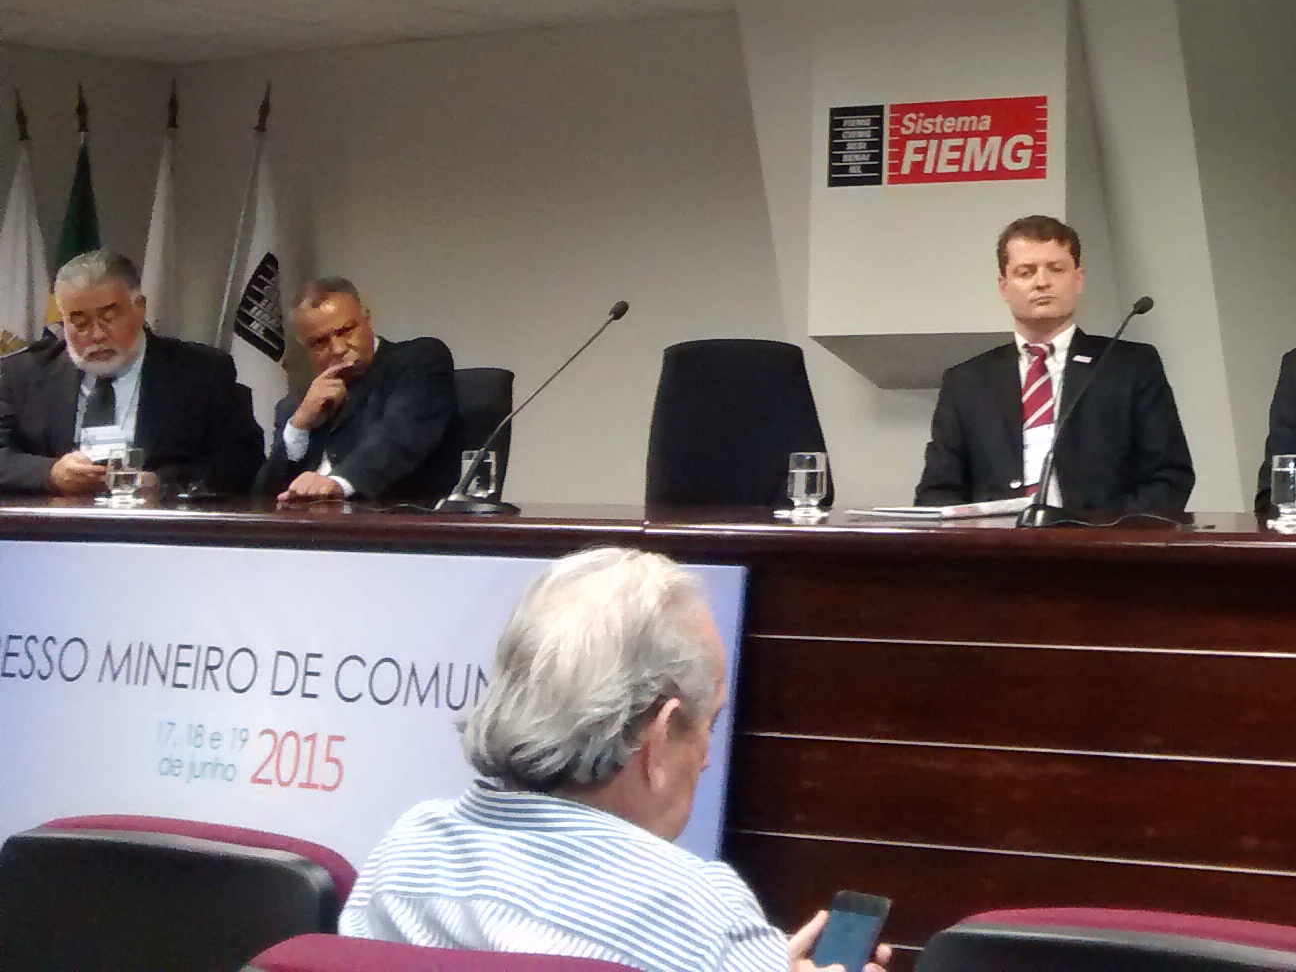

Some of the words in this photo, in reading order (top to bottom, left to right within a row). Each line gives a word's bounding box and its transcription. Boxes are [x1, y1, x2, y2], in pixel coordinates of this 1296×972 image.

[900, 112, 992, 135] Sistema
[901, 134, 1035, 175] FIEMG
[1, 634, 89, 683] ESSO
[98, 640, 259, 695] MINEIRO
[270, 650, 324, 699] DE
[158, 752, 184, 777] de
[185, 754, 239, 784] junho
[186, 723, 205, 749] 18
[209, 730, 224, 750] e
[231, 727, 250, 751] 19
[250, 728, 346, 792] 2015
